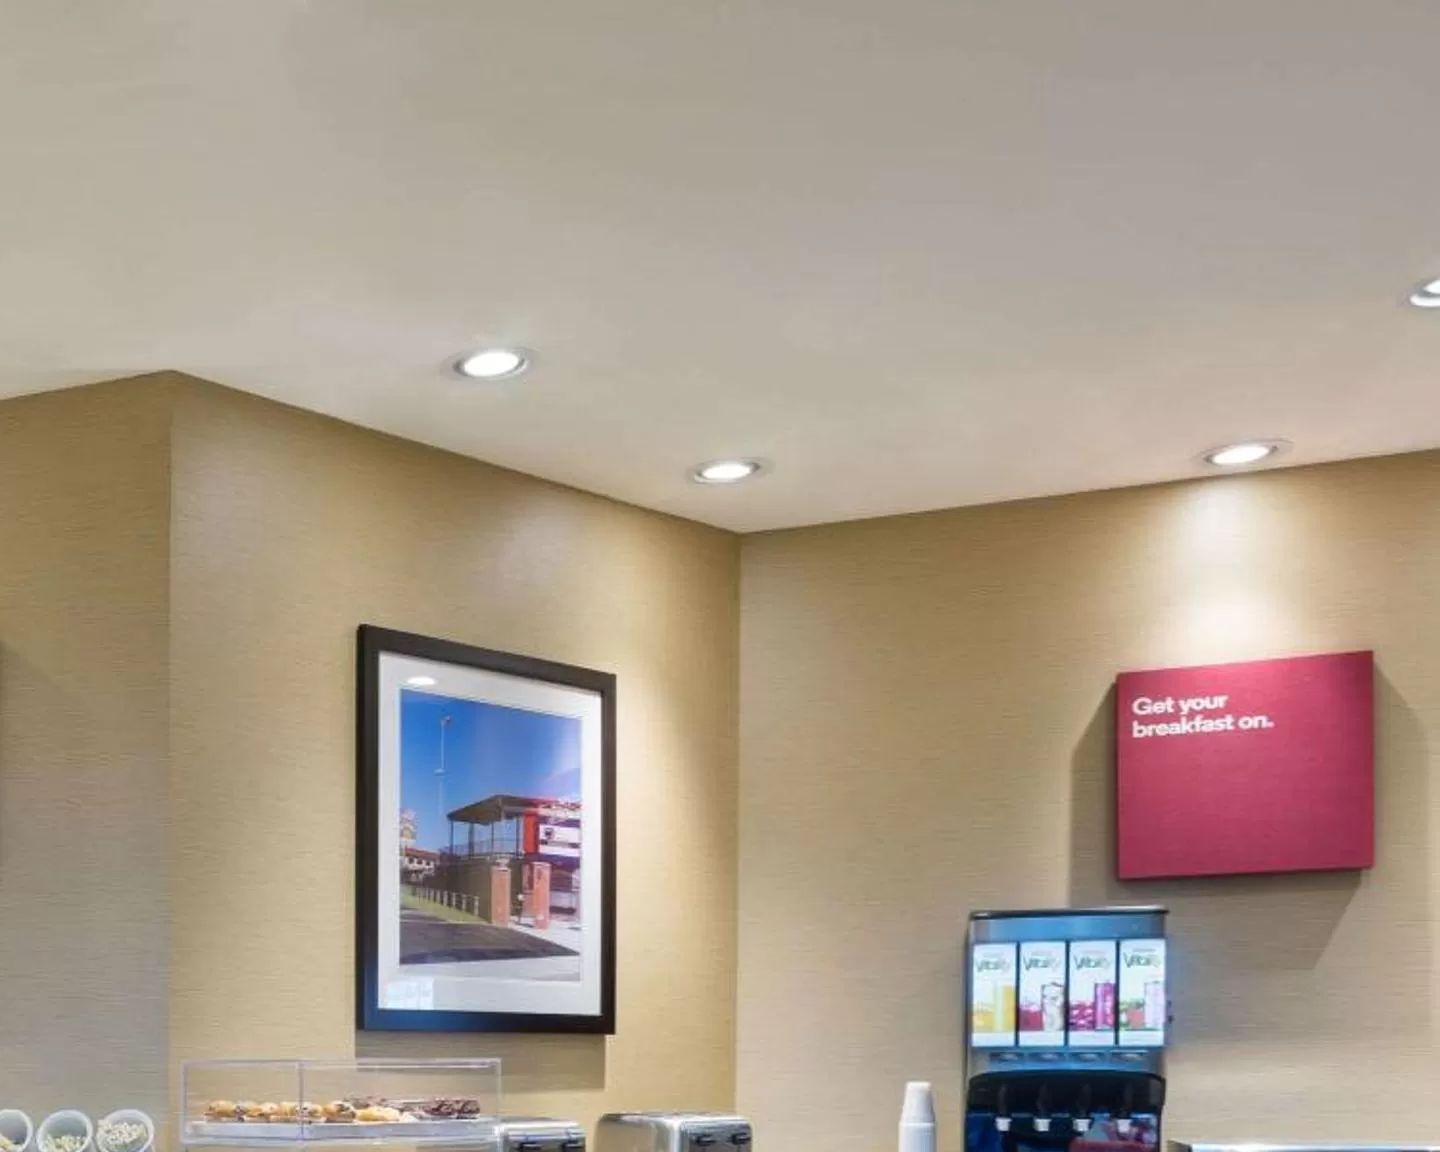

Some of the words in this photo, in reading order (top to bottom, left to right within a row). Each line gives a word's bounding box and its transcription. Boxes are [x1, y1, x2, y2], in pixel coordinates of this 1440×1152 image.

[1132, 697, 1175, 715] Get
[1178, 695, 1229, 715] your
[1132, 714, 1235, 738] breakfast
[1238, 714, 1275, 730] on.
